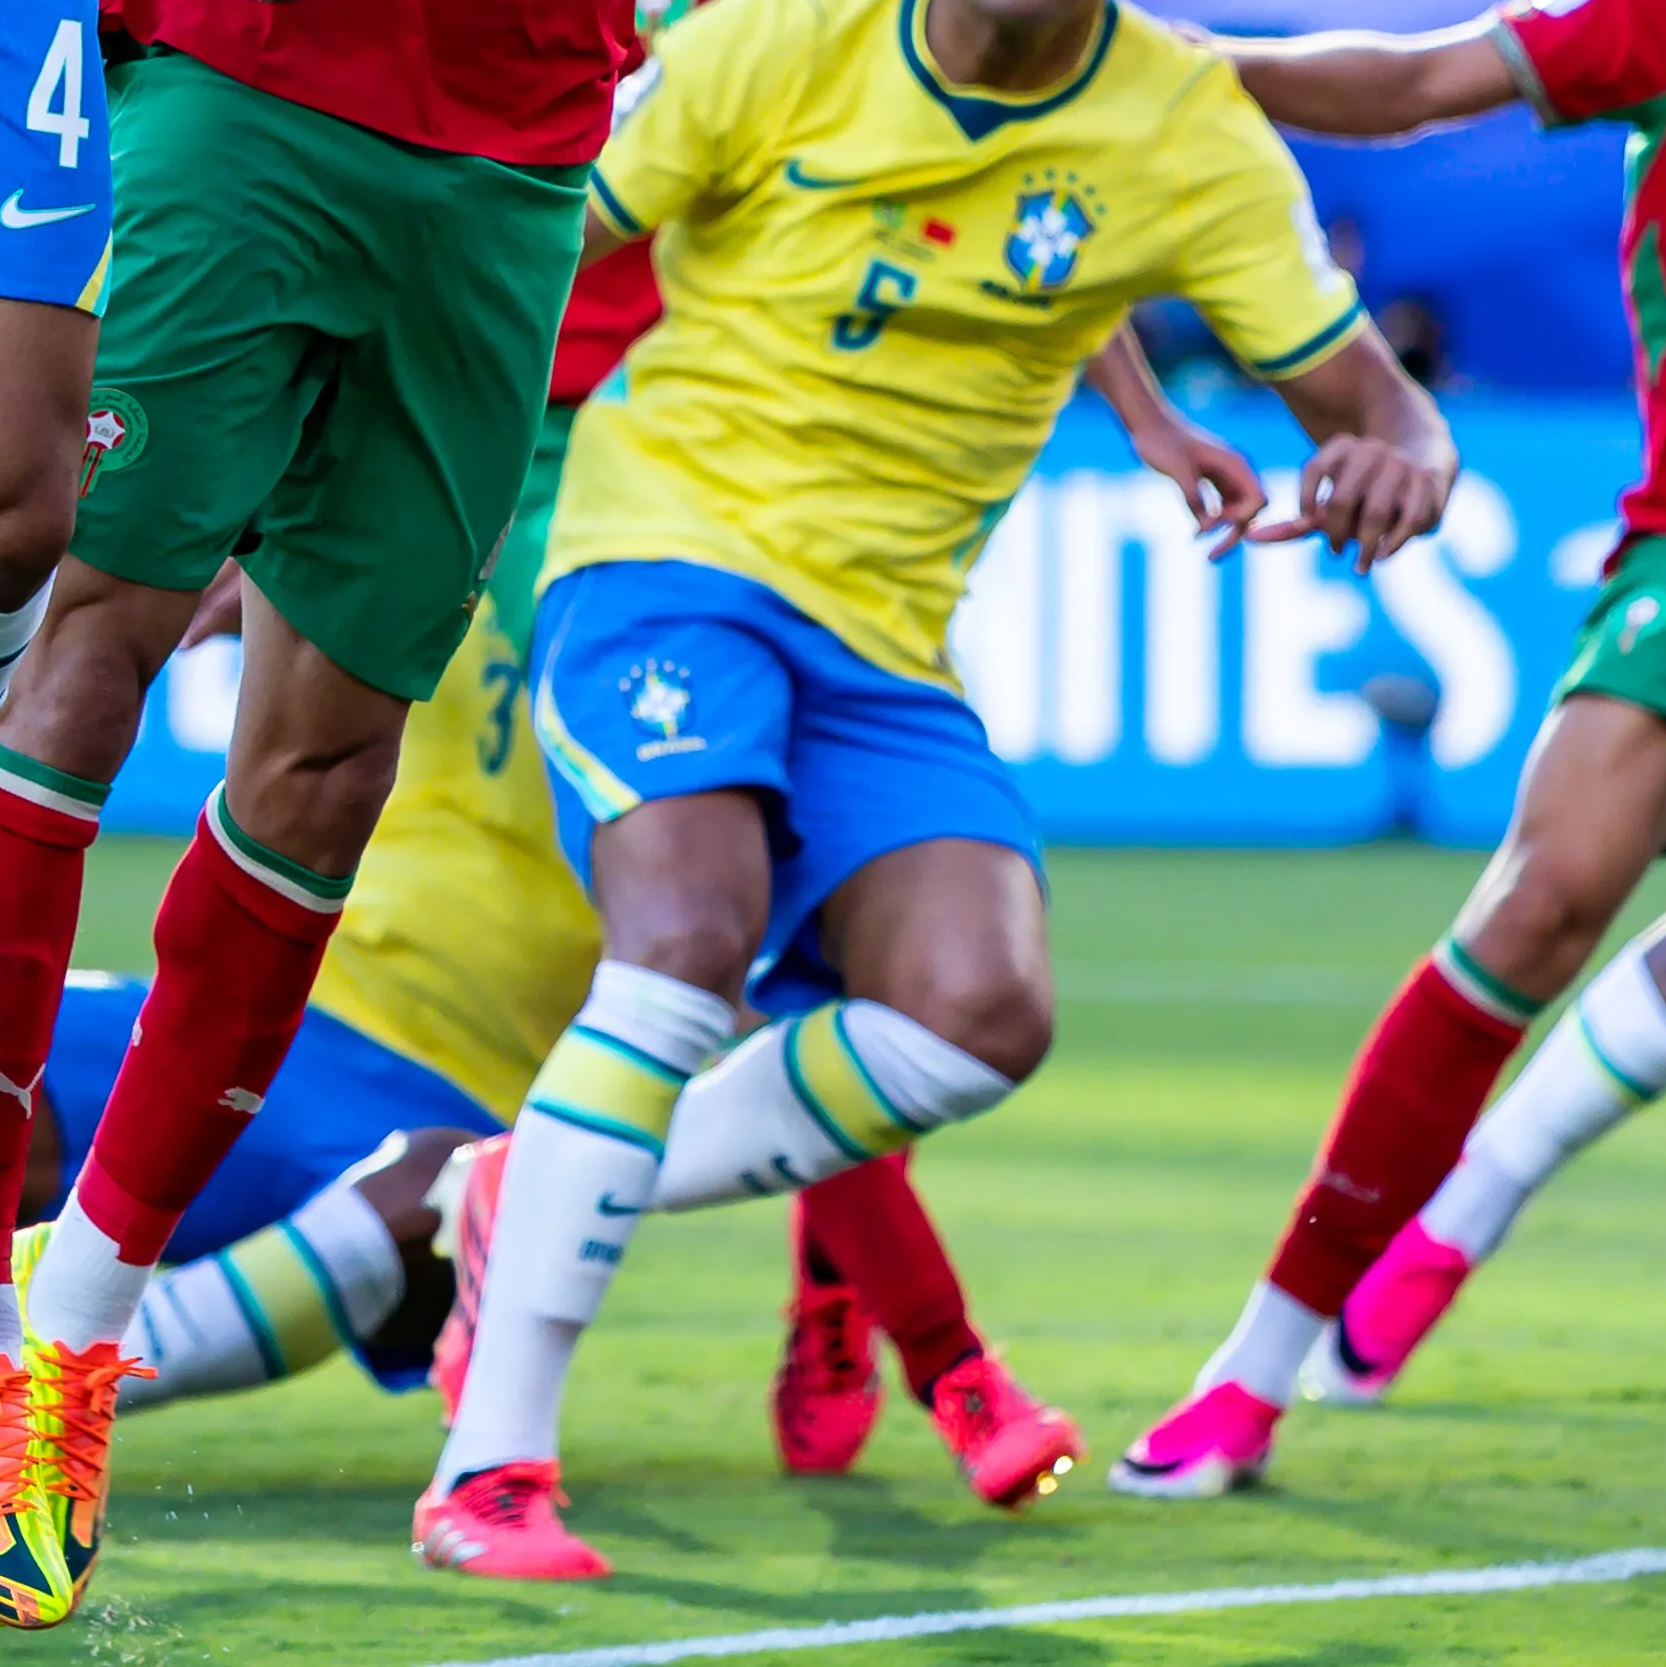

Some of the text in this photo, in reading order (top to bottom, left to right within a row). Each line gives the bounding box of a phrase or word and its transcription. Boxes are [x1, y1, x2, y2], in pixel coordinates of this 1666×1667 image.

[26, 19, 90, 169] 4
[832, 257, 917, 350] 5
[477, 662, 520, 777] 3
